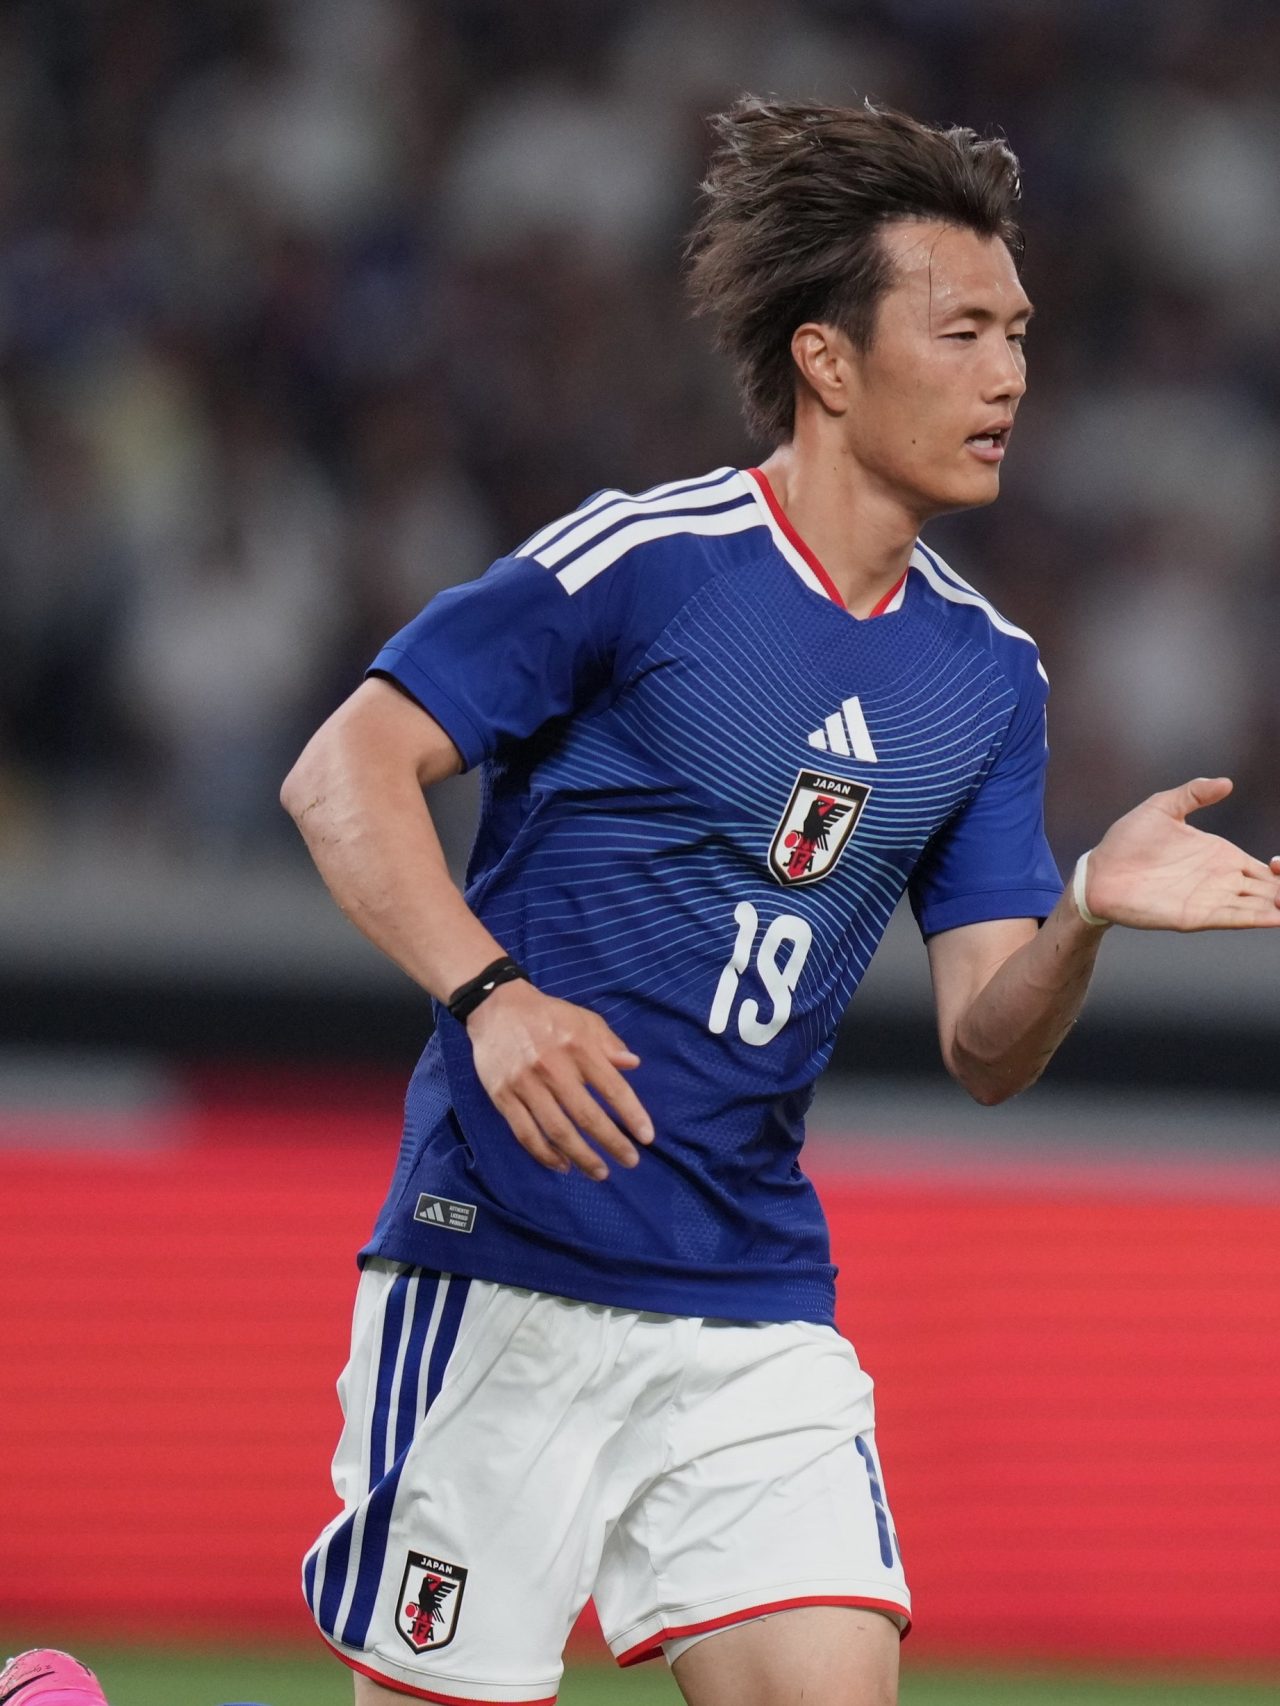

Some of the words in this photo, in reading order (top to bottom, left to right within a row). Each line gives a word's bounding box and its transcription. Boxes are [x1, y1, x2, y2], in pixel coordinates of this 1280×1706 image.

[813, 778, 851, 795] JAPAN
[782, 850, 814, 873] JFA
[708, 901, 813, 1046] 19
[855, 1435, 902, 1568] 1
[421, 1557, 453, 1575] JAPAN
[407, 1620, 435, 1642] JFA
